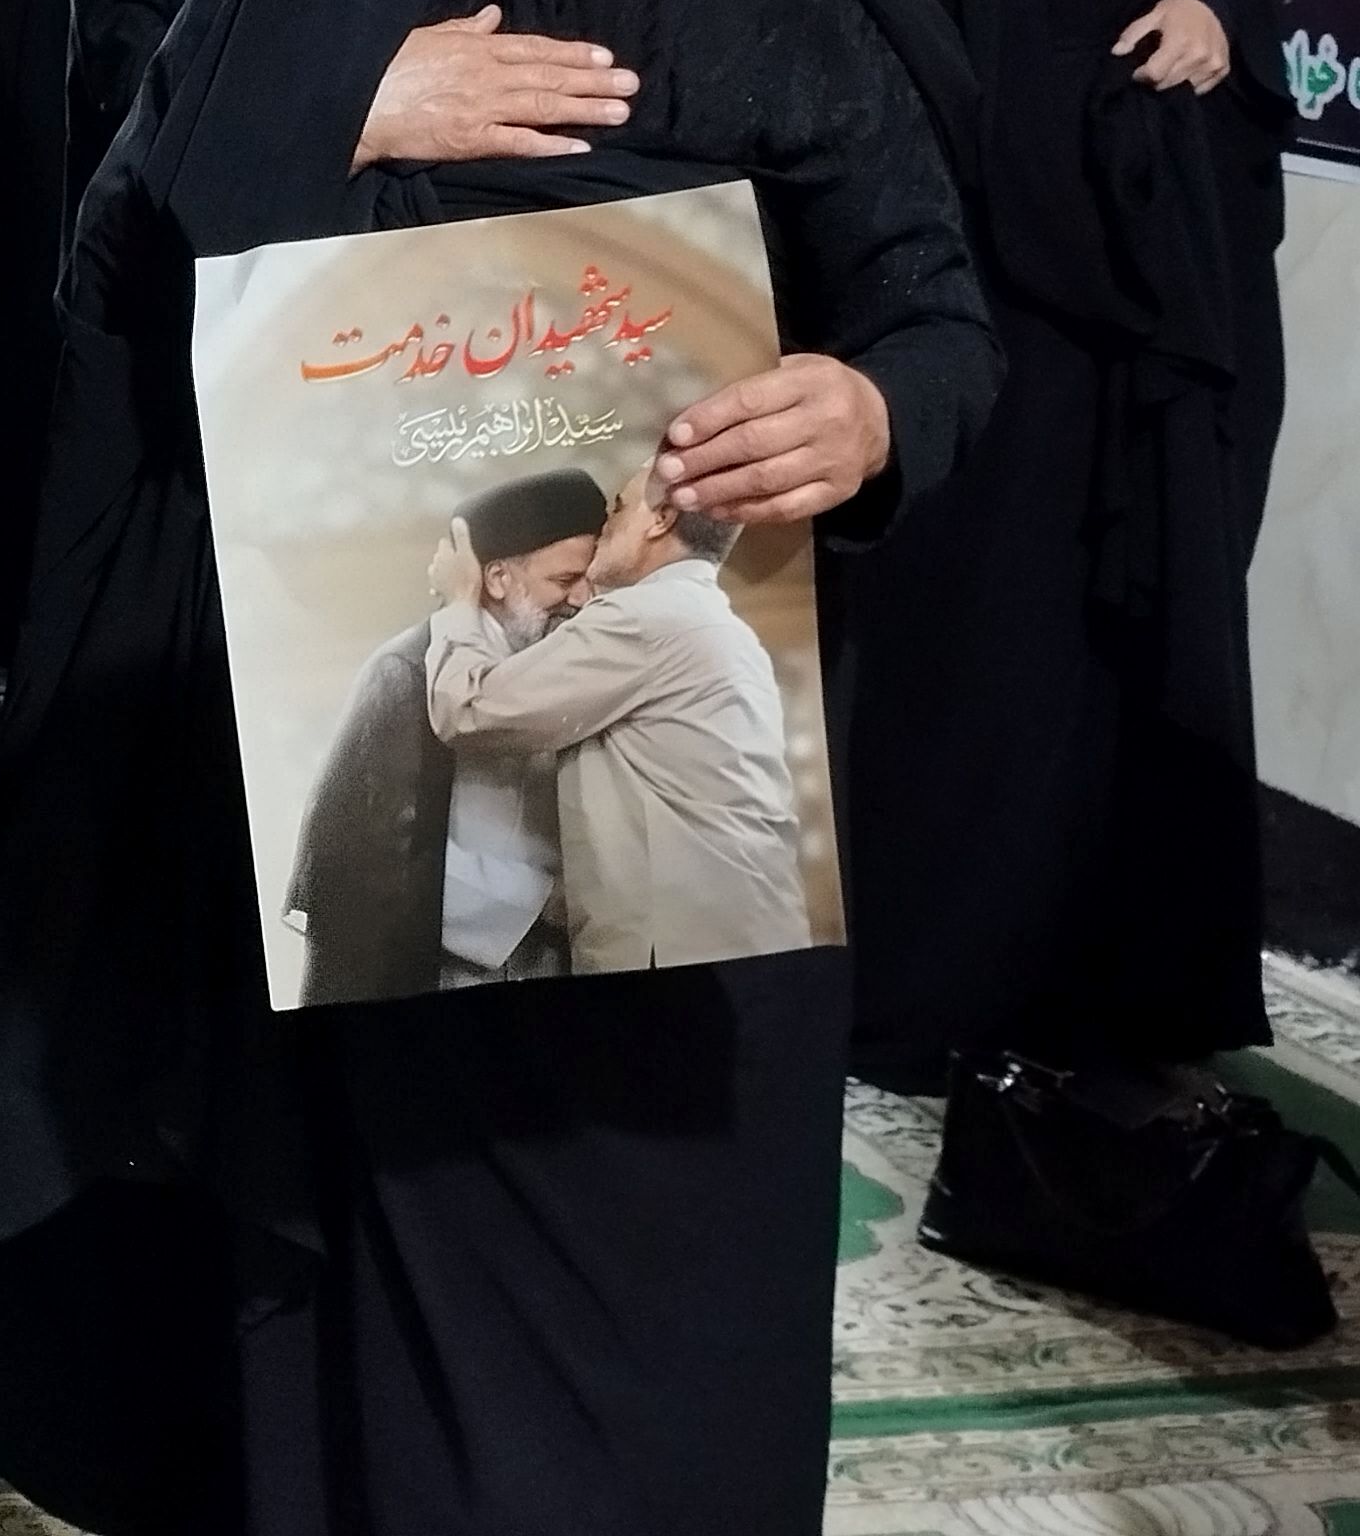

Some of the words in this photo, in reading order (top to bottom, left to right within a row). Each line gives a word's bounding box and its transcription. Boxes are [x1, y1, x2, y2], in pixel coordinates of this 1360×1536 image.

[300, 313, 457, 383] خدمت
[463, 265, 632, 380] شهیدان
[604, 306, 673, 365] سید
